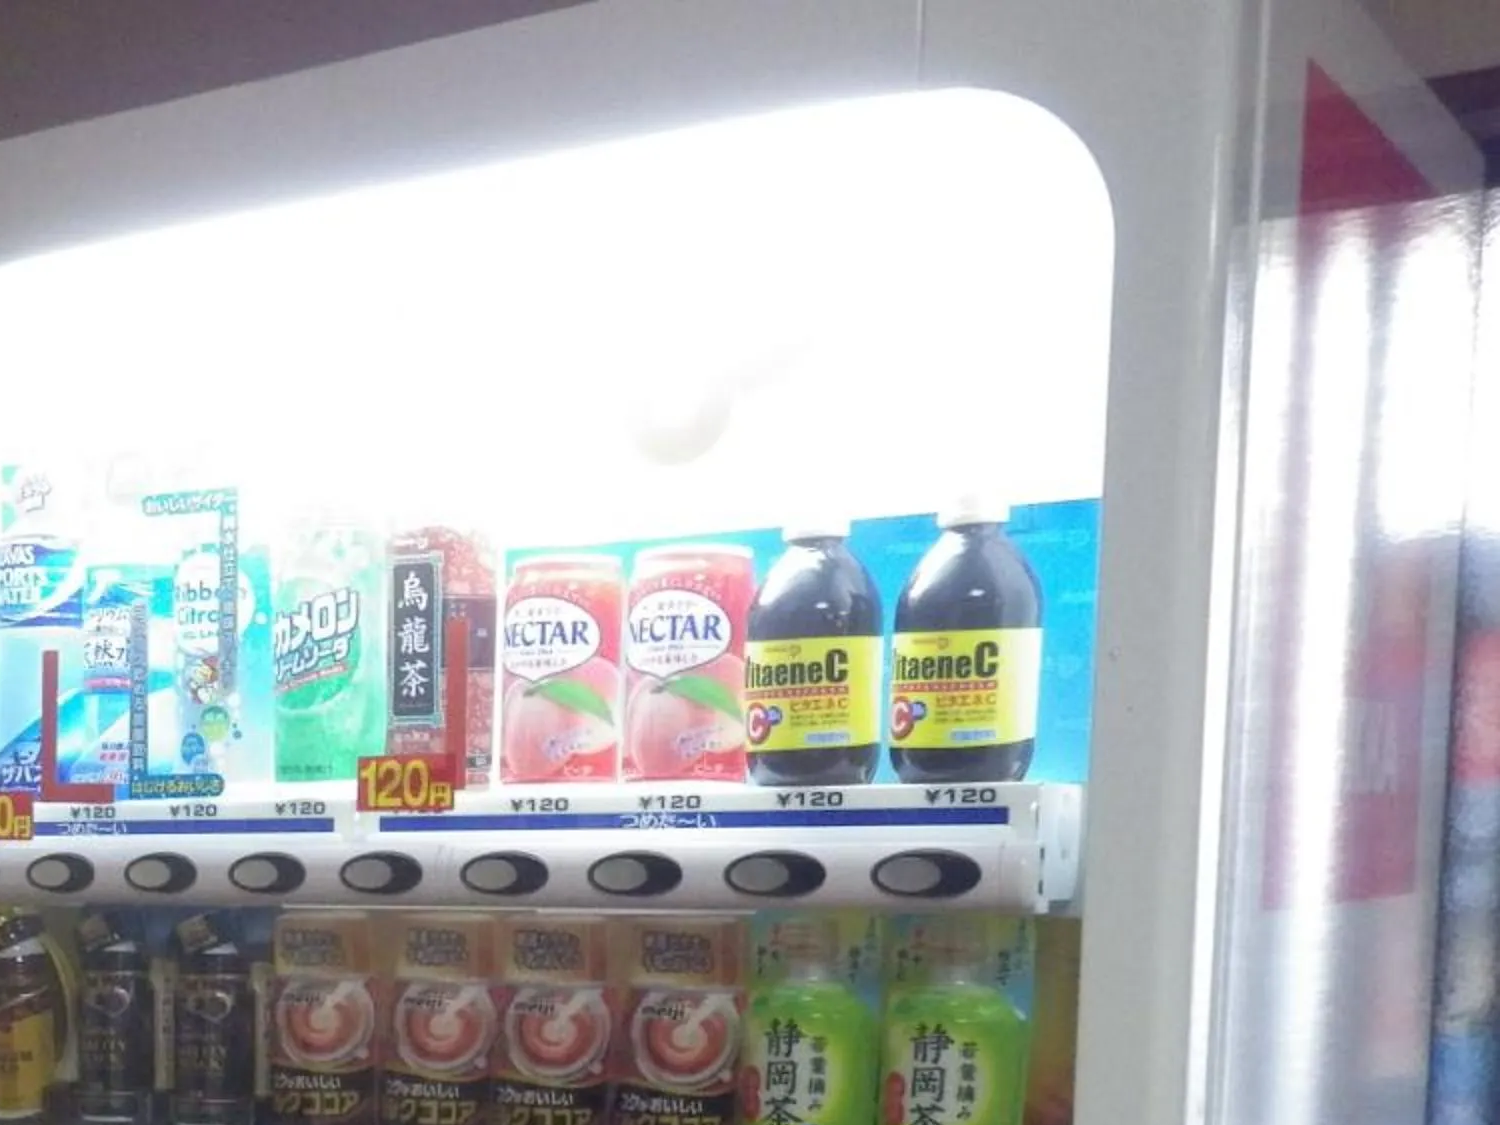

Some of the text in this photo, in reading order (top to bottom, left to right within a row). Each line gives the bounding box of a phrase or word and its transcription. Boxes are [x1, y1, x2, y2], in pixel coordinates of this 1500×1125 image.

[397, 570, 431, 697] 烏龍茶
[629, 614, 723, 642] NECTAR
[359, 762, 452, 808] 120円
[638, 795, 701, 810] ¥120
[777, 791, 843, 807] ¥120
[925, 788, 997, 805] ¥120
[70, 805, 116, 819] ¥120
[170, 804, 217, 818] ¥120
[275, 801, 325, 816] ¥120
[510, 797, 569, 812] ¥120
